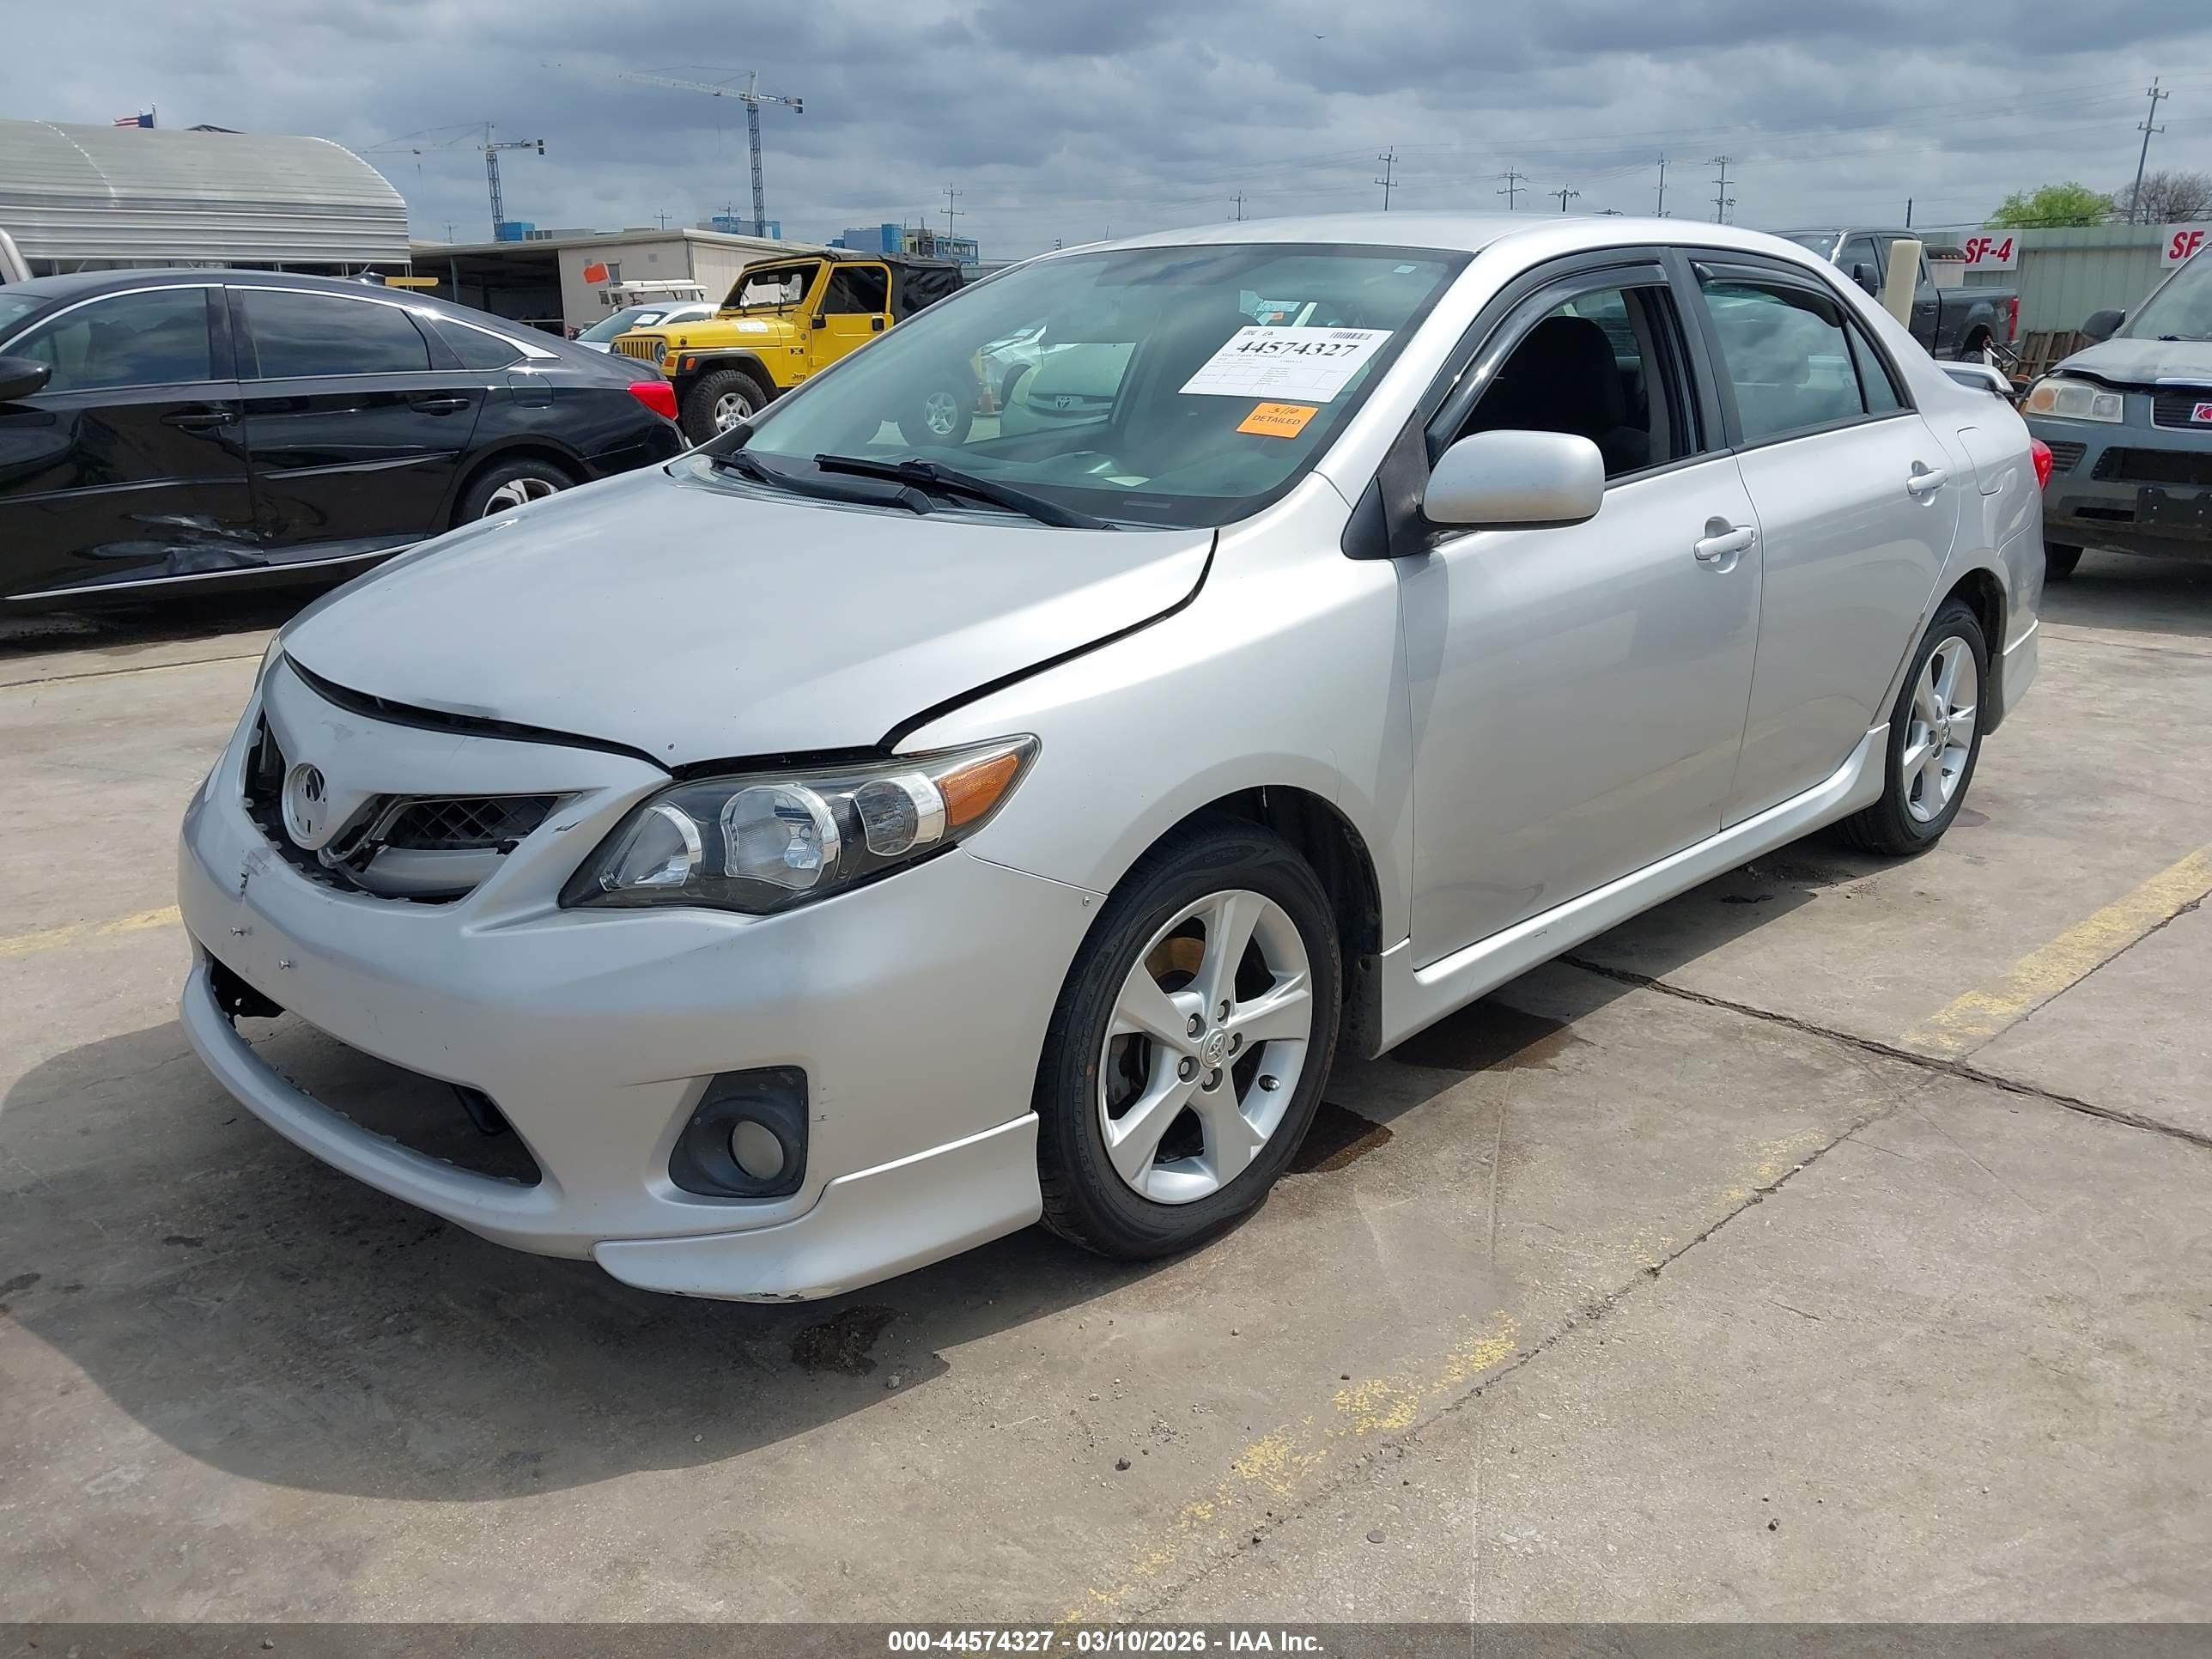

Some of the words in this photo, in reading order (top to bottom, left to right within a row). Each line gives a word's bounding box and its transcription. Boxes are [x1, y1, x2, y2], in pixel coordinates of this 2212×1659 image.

[1965, 237, 2014, 264] SF-4
[1237, 341, 1360, 357] 44574327
[1252, 415, 1301, 425] DETAILED
